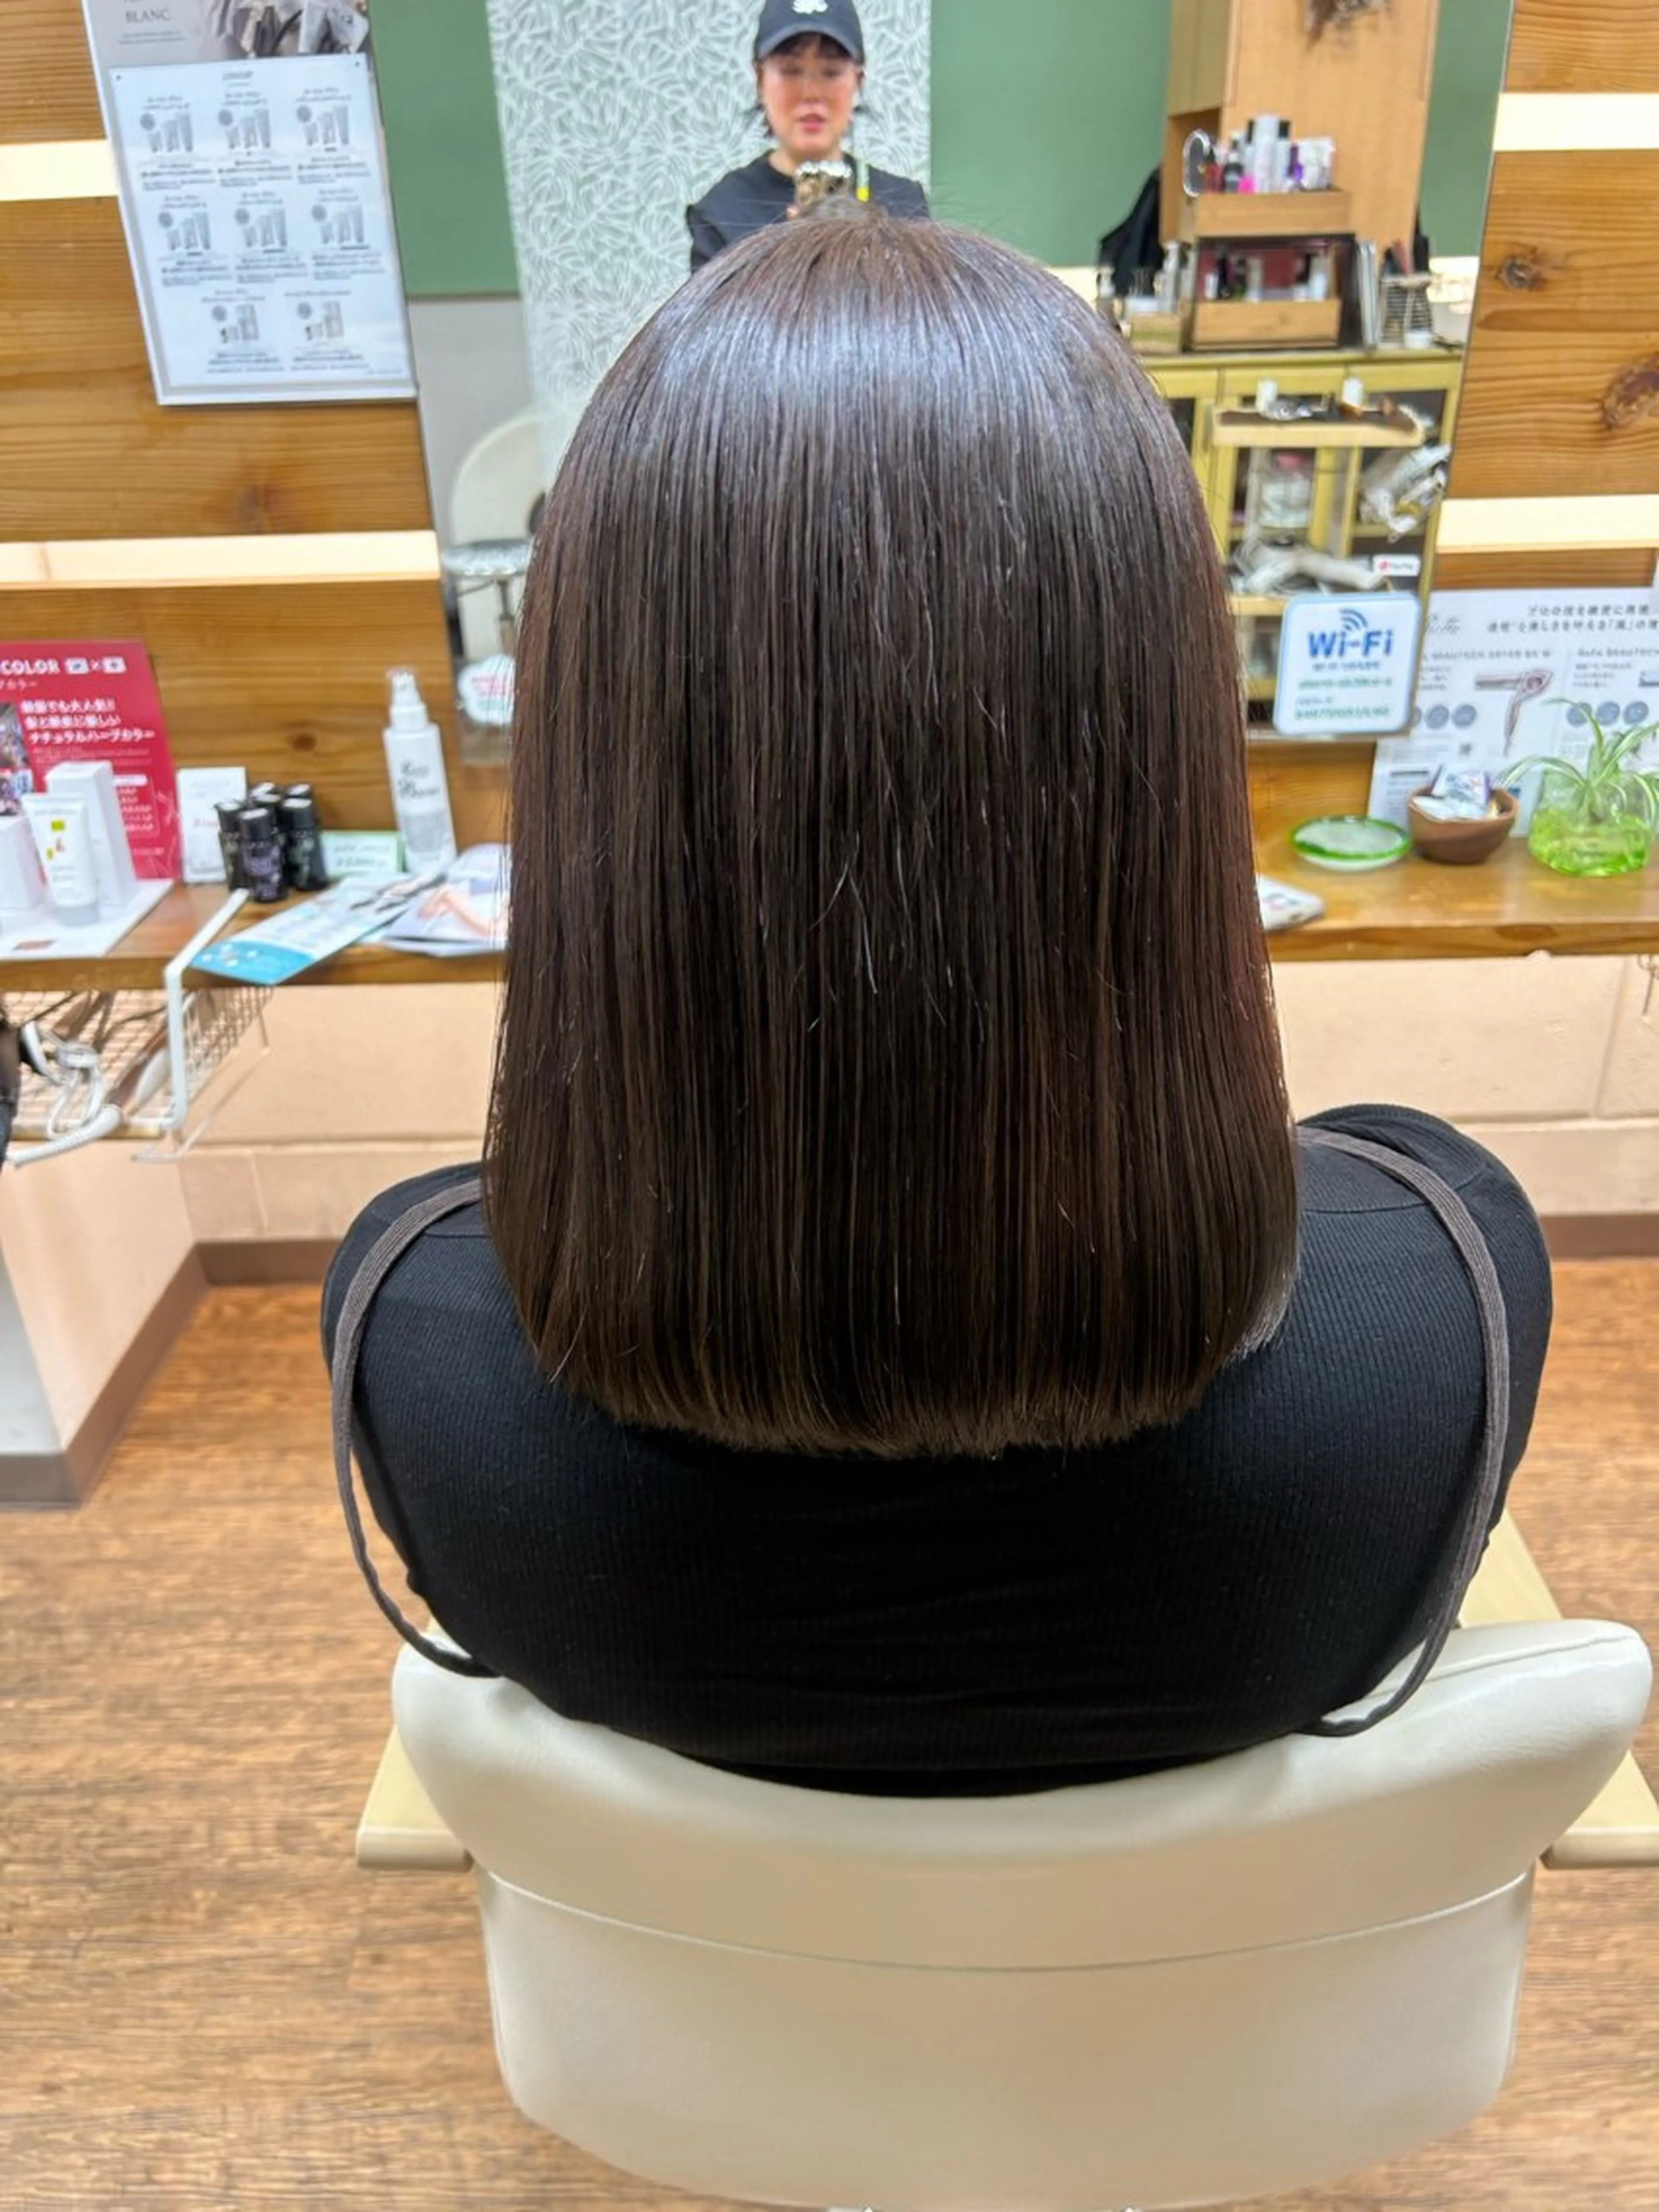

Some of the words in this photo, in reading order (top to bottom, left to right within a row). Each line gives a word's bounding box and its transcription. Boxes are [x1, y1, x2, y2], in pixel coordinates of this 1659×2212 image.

[125, 8, 172, 24] BLANC
[1308, 629, 1393, 658] Wi-Fi
[0, 659, 60, 674] COLOR
